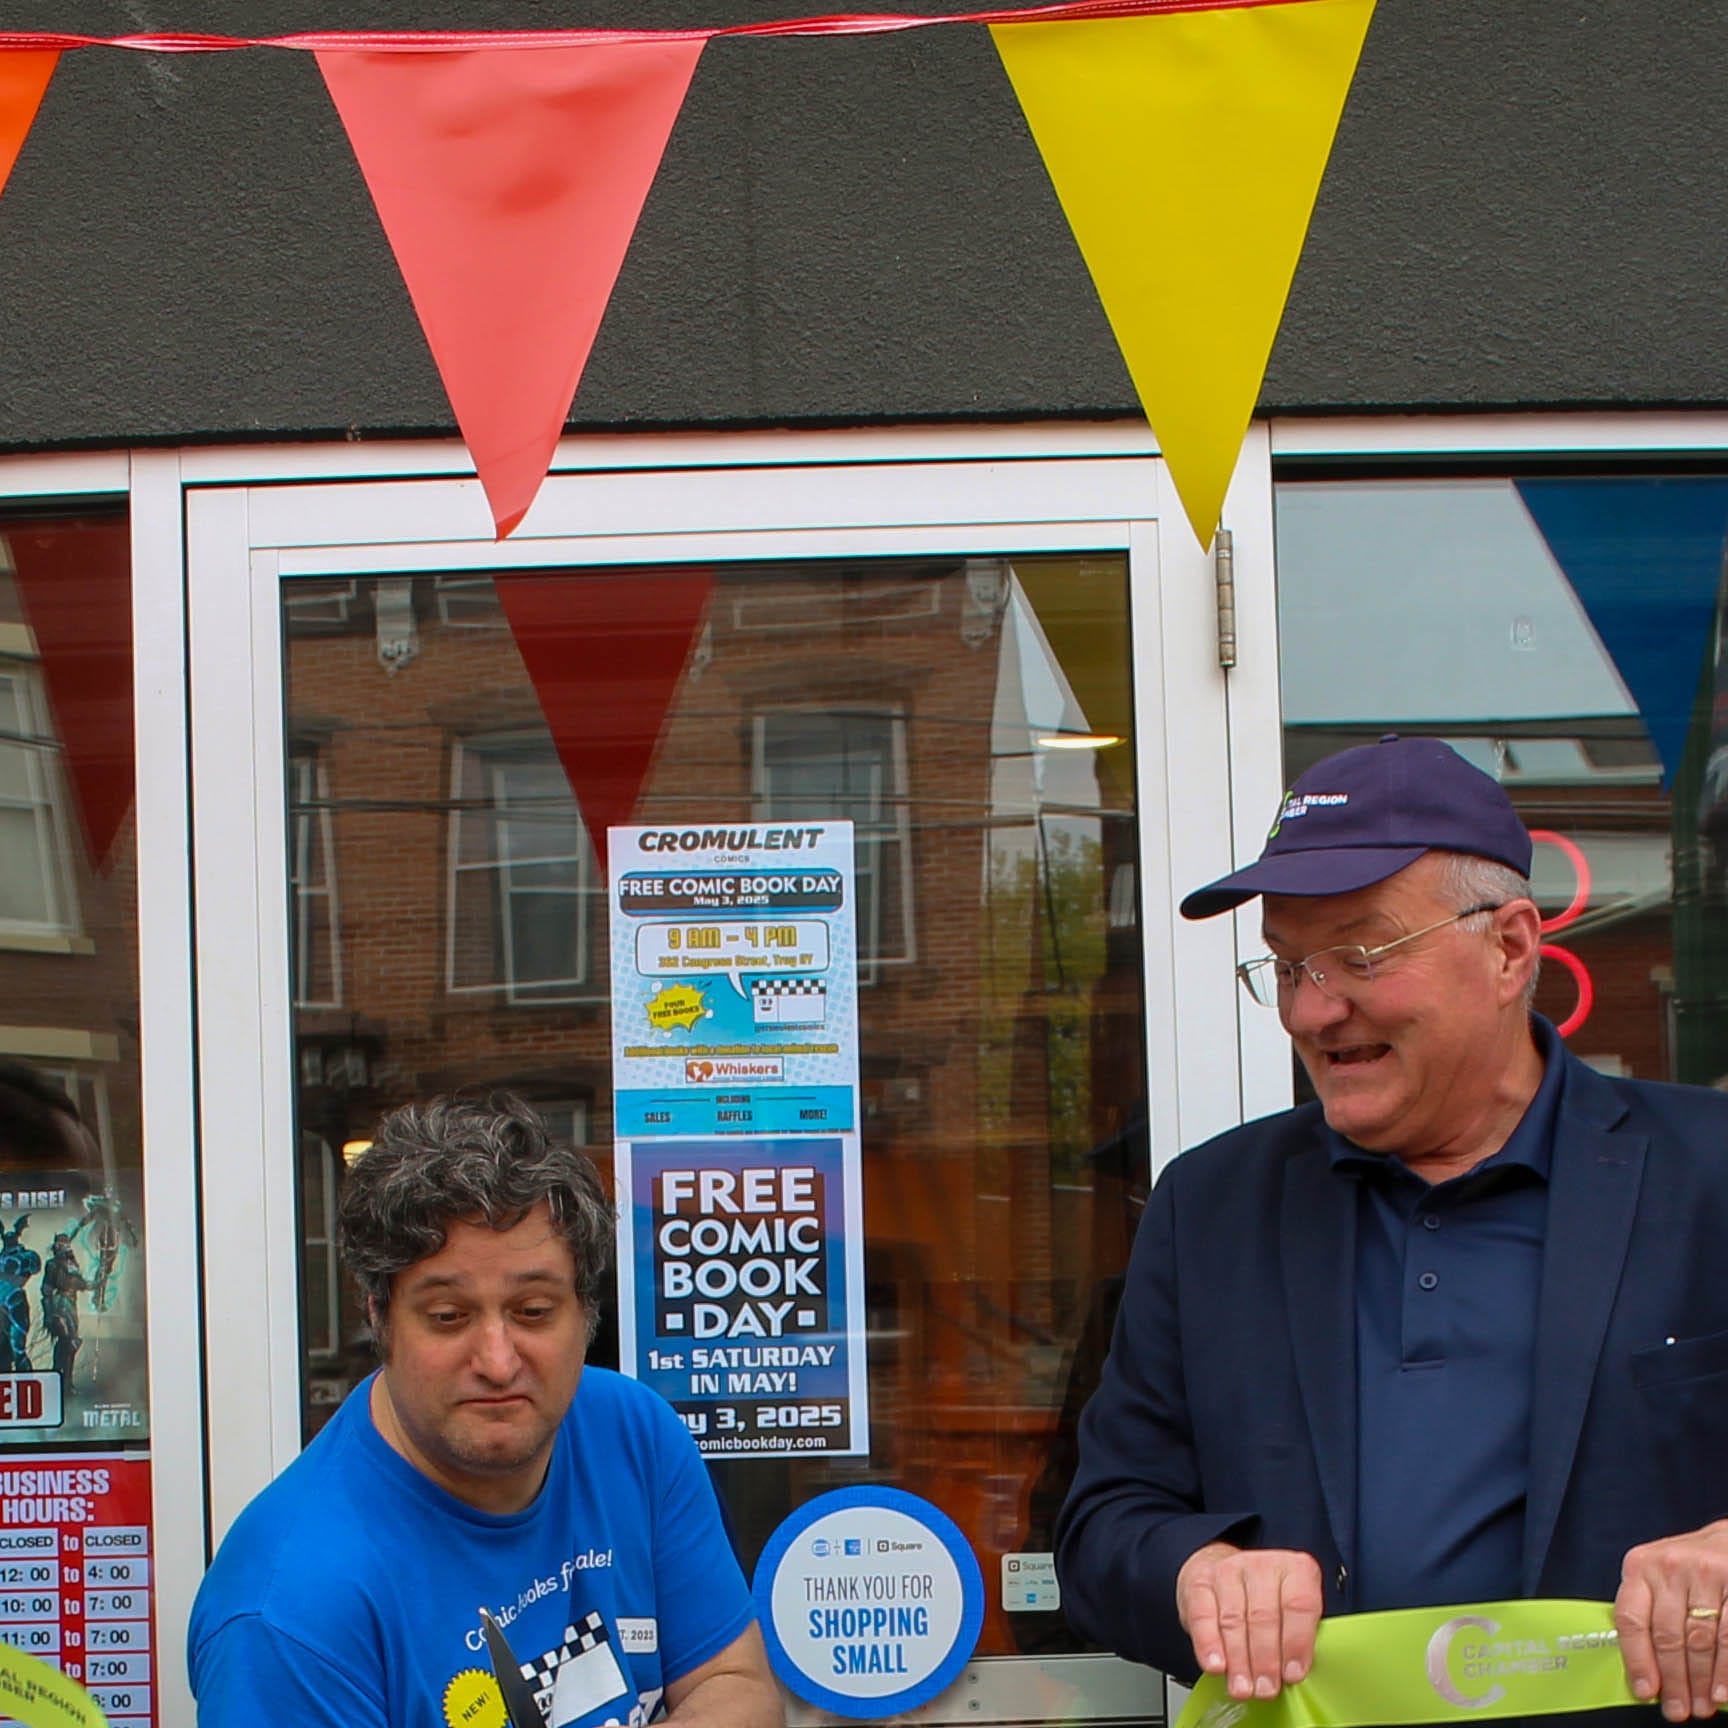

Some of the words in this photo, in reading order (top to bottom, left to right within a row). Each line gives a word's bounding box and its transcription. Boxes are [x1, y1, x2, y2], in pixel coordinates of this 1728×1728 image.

[1303, 794, 1349, 806] REGION
[638, 828, 825, 853] CROMULENT
[714, 855, 750, 864] COMICS
[620, 879, 664, 896] FREE
[669, 877, 736, 895] COMIC
[741, 877, 798, 894] BOOK
[694, 896, 719, 906] May
[721, 896, 733, 906] 3,
[736, 895, 769, 905] 2025
[668, 928, 681, 949] 9
[687, 927, 721, 948] AM
[744, 927, 758, 947] 4
[764, 926, 797, 947] PM
[716, 1062, 779, 1075] Whiskers
[644, 1112, 671, 1123] SALES
[717, 1111, 752, 1122] RAFFLES
[18, 1190, 65, 1209] RISE!
[660, 1167, 817, 1216] FREE
[659, 1216, 820, 1257] COMIC
[663, 1257, 822, 1299] BOOK
[692, 1301, 797, 1340] DAY
[648, 1350, 685, 1370] 1st
[692, 1345, 836, 1369] SATURDAY
[690, 1373, 720, 1394] IN
[728, 1372, 797, 1394] MAY!
[83, 1409, 141, 1427] METAL
[715, 1407, 746, 1432] 3,
[756, 1404, 842, 1428] 2025
[2, 1498, 94, 1524] HOURS:
[63, 1534, 79, 1551] to
[85, 1534, 142, 1547] CLOSED
[575, 1549, 613, 1570] ale!
[64, 1566, 80, 1583] to
[804, 1576, 860, 1601] THANK
[861, 1575, 896, 1600] YOU
[902, 1574, 933, 1600] FOR
[64, 1598, 80, 1615] to
[809, 1607, 928, 1639] SHOPPING
[64, 1631, 81, 1646] to
[1462, 1637, 1550, 1660] CAPITAL
[1556, 1629, 1619, 1651] REGIO
[64, 1662, 81, 1678] to
[832, 1643, 908, 1675] SMALL
[1463, 1656, 1568, 1680] CHAMBER
[27, 1680, 87, 1725] REGION
[462, 1691, 490, 1722] NEW!
